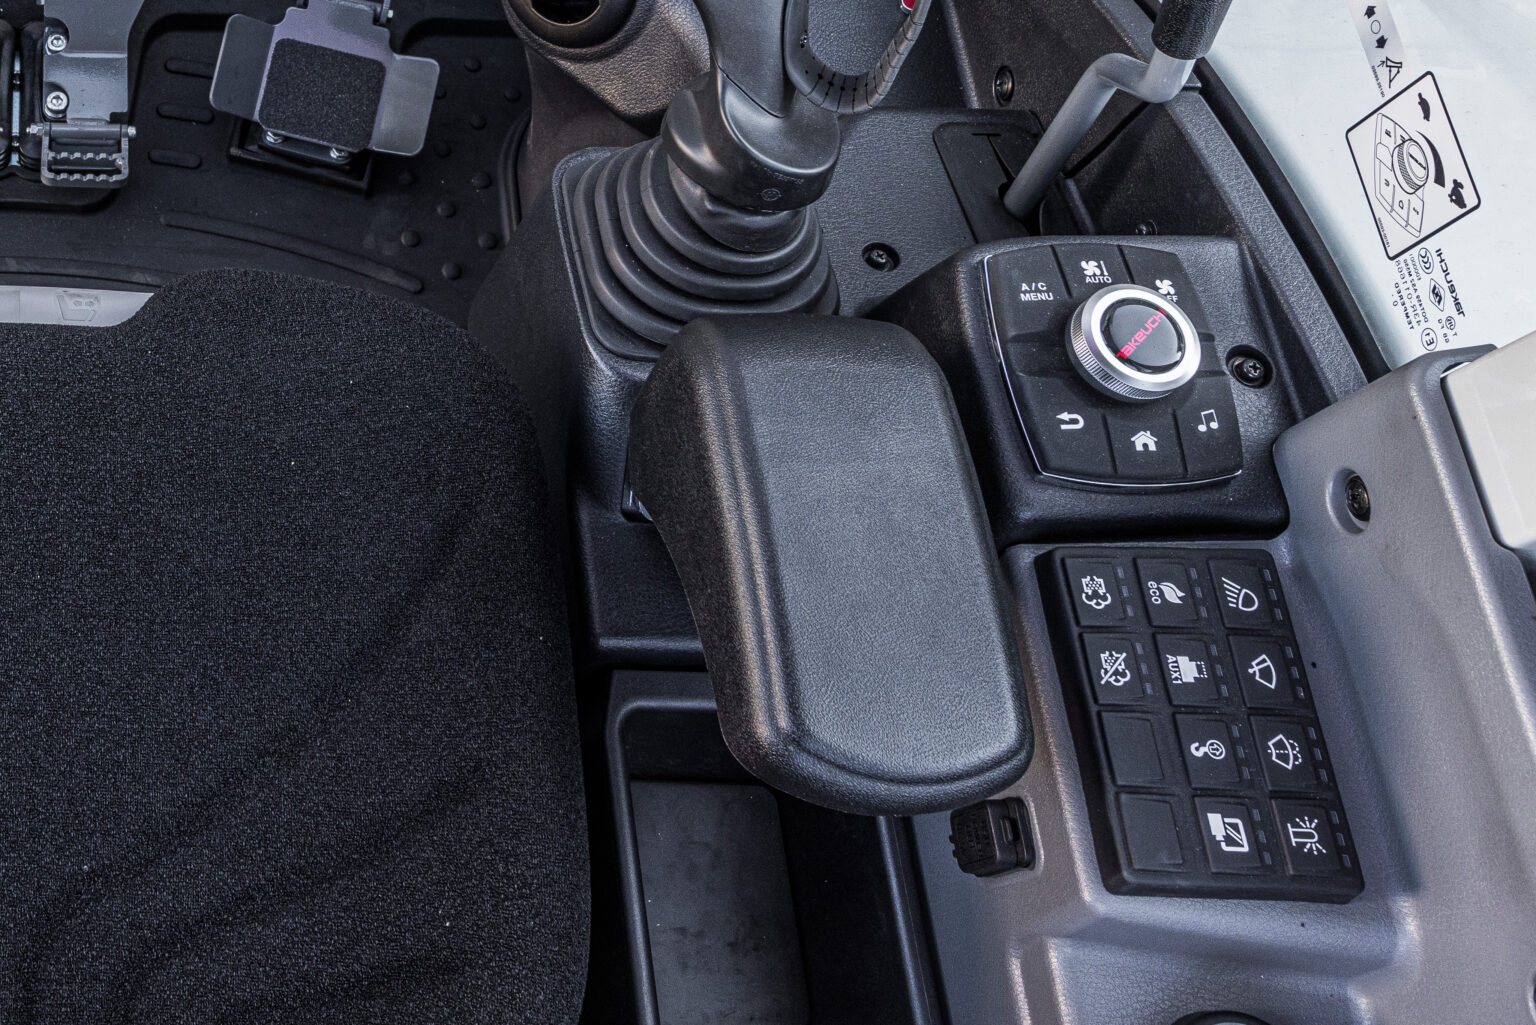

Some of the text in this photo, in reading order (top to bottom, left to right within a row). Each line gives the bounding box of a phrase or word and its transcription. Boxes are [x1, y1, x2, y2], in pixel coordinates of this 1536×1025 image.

[1085, 276, 1112, 284] AUTO
[1020, 293, 1053, 301] MENU
[1116, 308, 1168, 359] TAKEUCHI
[1147, 581, 1162, 605] eco
[1166, 654, 1183, 685] AUX1
